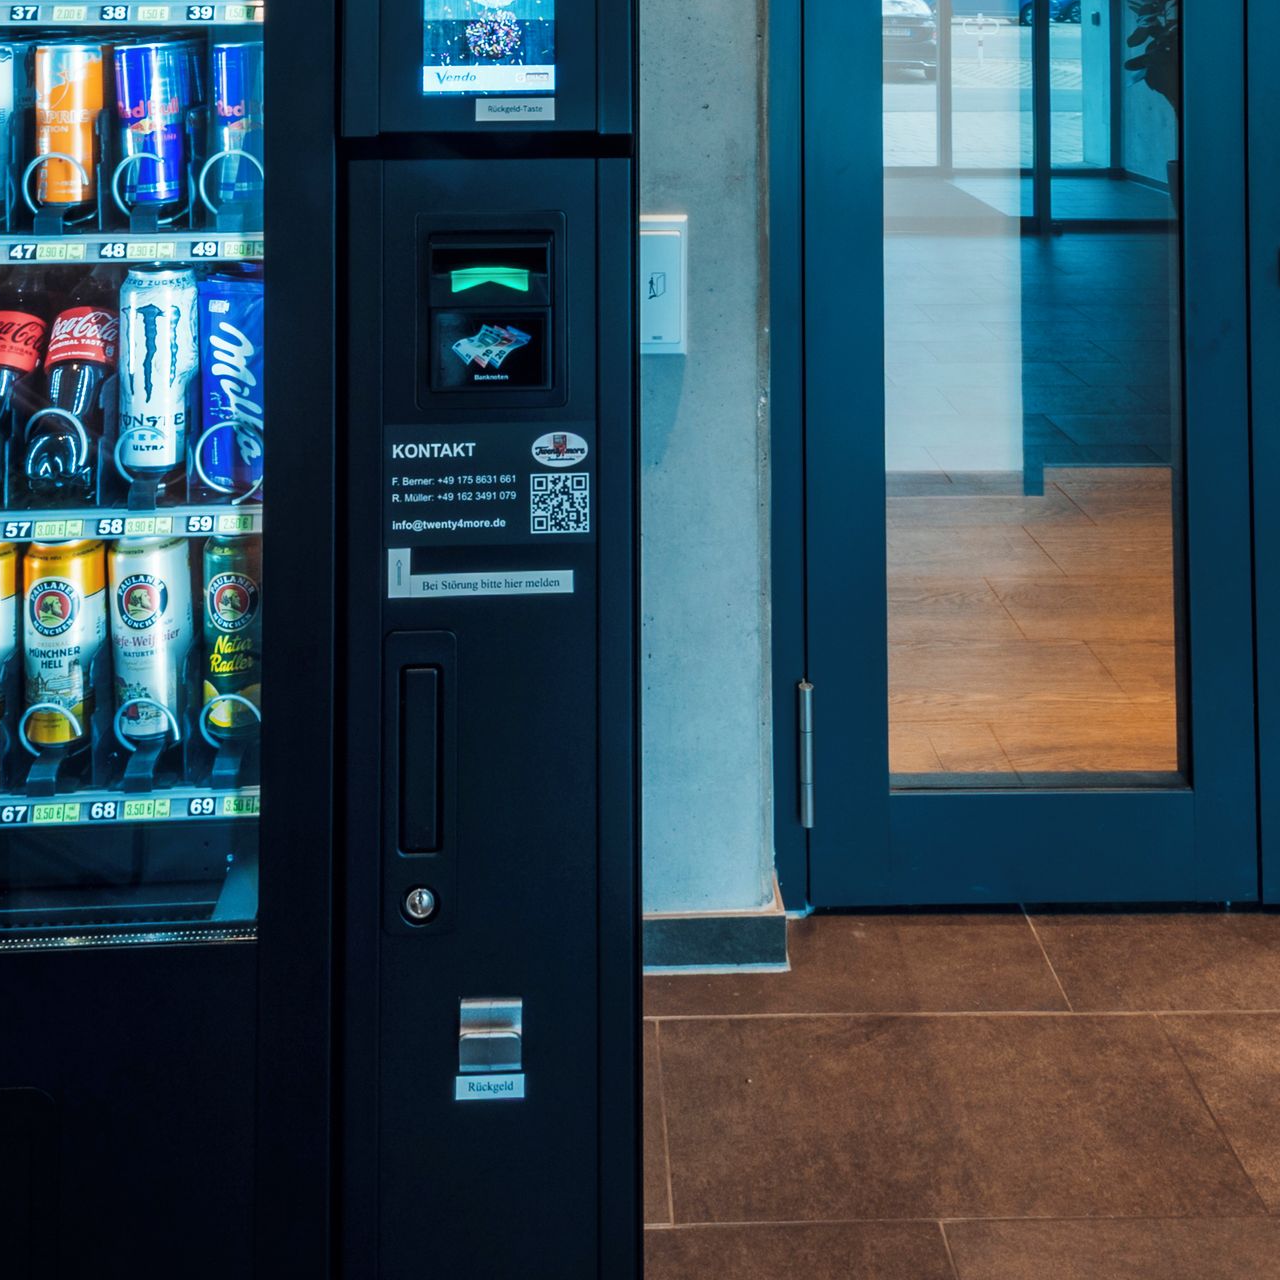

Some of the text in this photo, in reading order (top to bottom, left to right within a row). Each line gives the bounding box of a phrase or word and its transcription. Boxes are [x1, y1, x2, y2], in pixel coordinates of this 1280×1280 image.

[12, 6, 38, 20] 37
[102, 6, 126, 20] 38
[188, 5, 213, 20] 39
[435, 71, 477, 86] Vendo
[217, 100, 245, 117] Red
[487, 104, 543, 116] Rückgeld-Taste
[10, 244, 36, 259] 47
[101, 243, 126, 258] 48
[192, 242, 217, 256] 49
[148, 276, 187, 287] ZUCKER
[474, 373, 509, 381] Banknoten
[209, 321, 264, 466] Milka
[392, 442, 476, 459] KONTAKT
[392, 475, 516, 486] F. Berner: +49 175 8631 661
[392, 491, 517, 503] R. Müller: +49 162 3491 079
[5, 522, 31, 538] 57
[99, 519, 124, 535] 58
[188, 516, 212, 532] 59
[392, 517, 507, 532] info@twenty4more.de
[30, 581, 76, 602] PAULANER
[118, 575, 166, 596] PAULANER
[210, 575, 255, 595] PAULANER
[422, 578, 560, 592] Bei Störung bitte hier melden
[32, 618, 74, 637] MÜNCHEN
[213, 612, 252, 629] MÜNCHEN
[214, 634, 253, 654] Natur
[29, 645, 81, 660] MÜNCHNER
[41, 659, 63, 669] HELL
[210, 654, 254, 673] Radler
[91, 803, 116, 819] 68
[190, 799, 215, 815] 69
[2, 807, 27, 823] 67
[468, 1081, 514, 1094] Rückgeld
